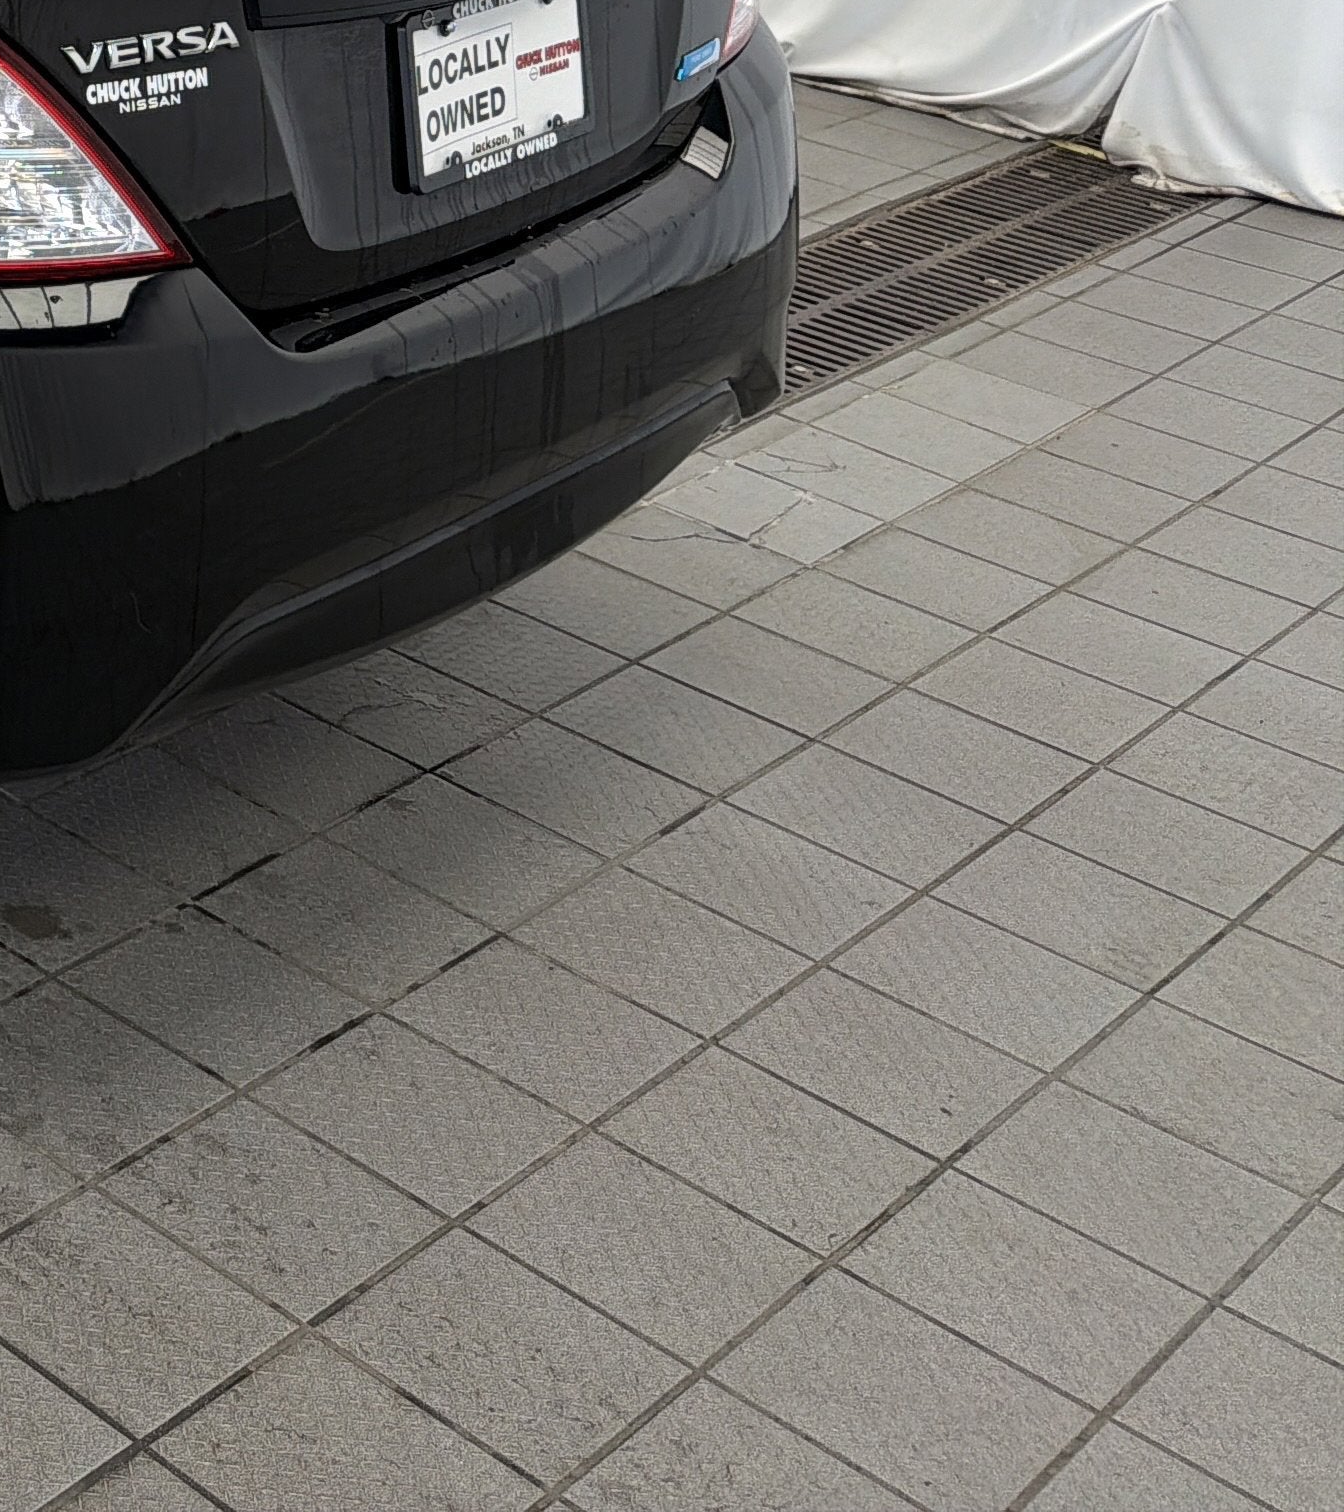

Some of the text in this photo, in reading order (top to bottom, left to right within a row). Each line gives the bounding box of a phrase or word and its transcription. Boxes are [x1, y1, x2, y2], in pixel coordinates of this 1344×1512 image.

[61, 21, 240, 74] VERSA
[416, 33, 510, 96] LOCALLY
[515, 38, 581, 70] CHUCK HUTTON
[539, 57, 569, 77] NISSAN
[86, 66, 209, 105] CHUCK HUTTON
[119, 92, 182, 114] NISSAN
[426, 86, 506, 142] OWNED
[465, 132, 558, 179] LOCALLY OWNED
[471, 123, 525, 155] Jackson, TN
